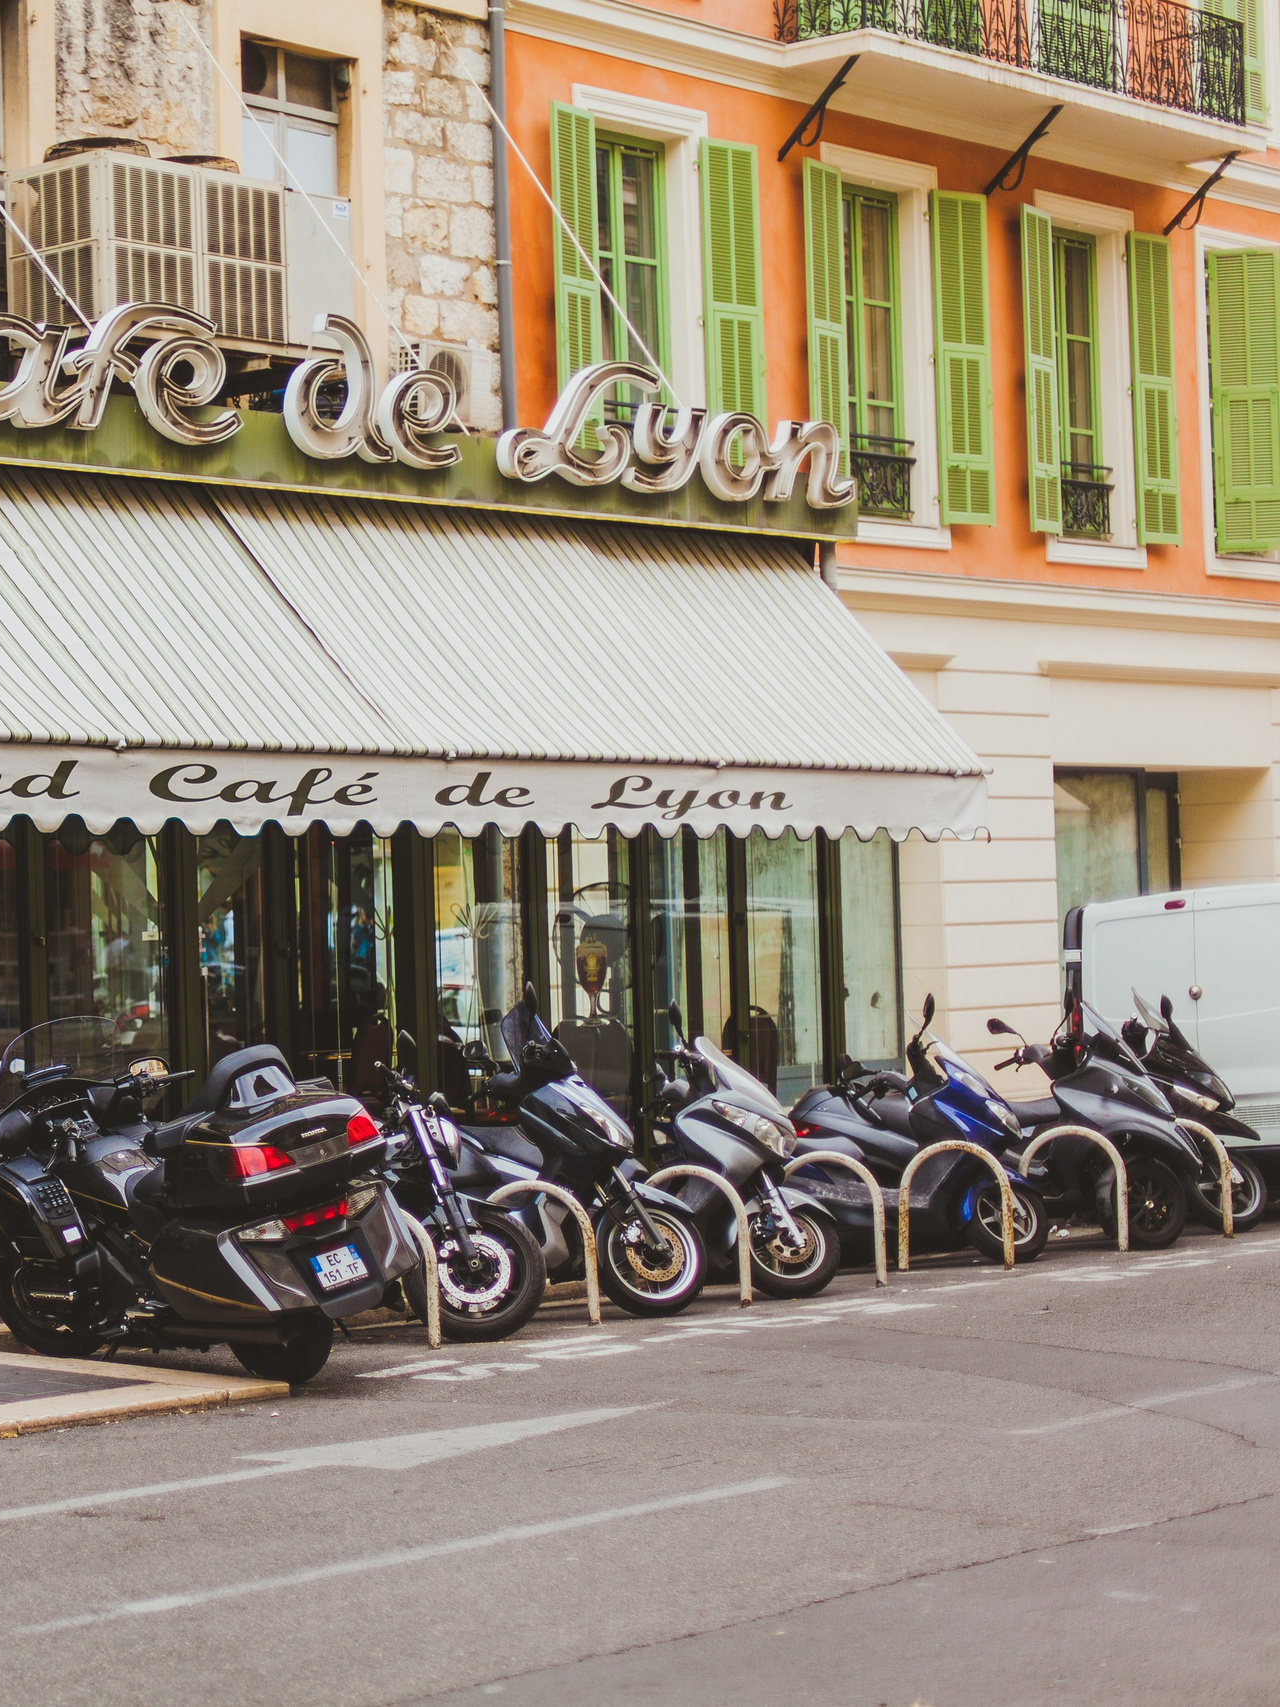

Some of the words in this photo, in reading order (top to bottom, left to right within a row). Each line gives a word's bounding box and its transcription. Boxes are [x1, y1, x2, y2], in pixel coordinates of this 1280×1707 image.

[283, 313, 462, 469] de
[496, 360, 856, 509] Lyon
[149, 763, 380, 816] Café
[435, 771, 534, 808] de
[591, 775, 793, 820] Lyon
[301, 1127, 327, 1138] HONDA
[326, 1253, 341, 1266] EC
